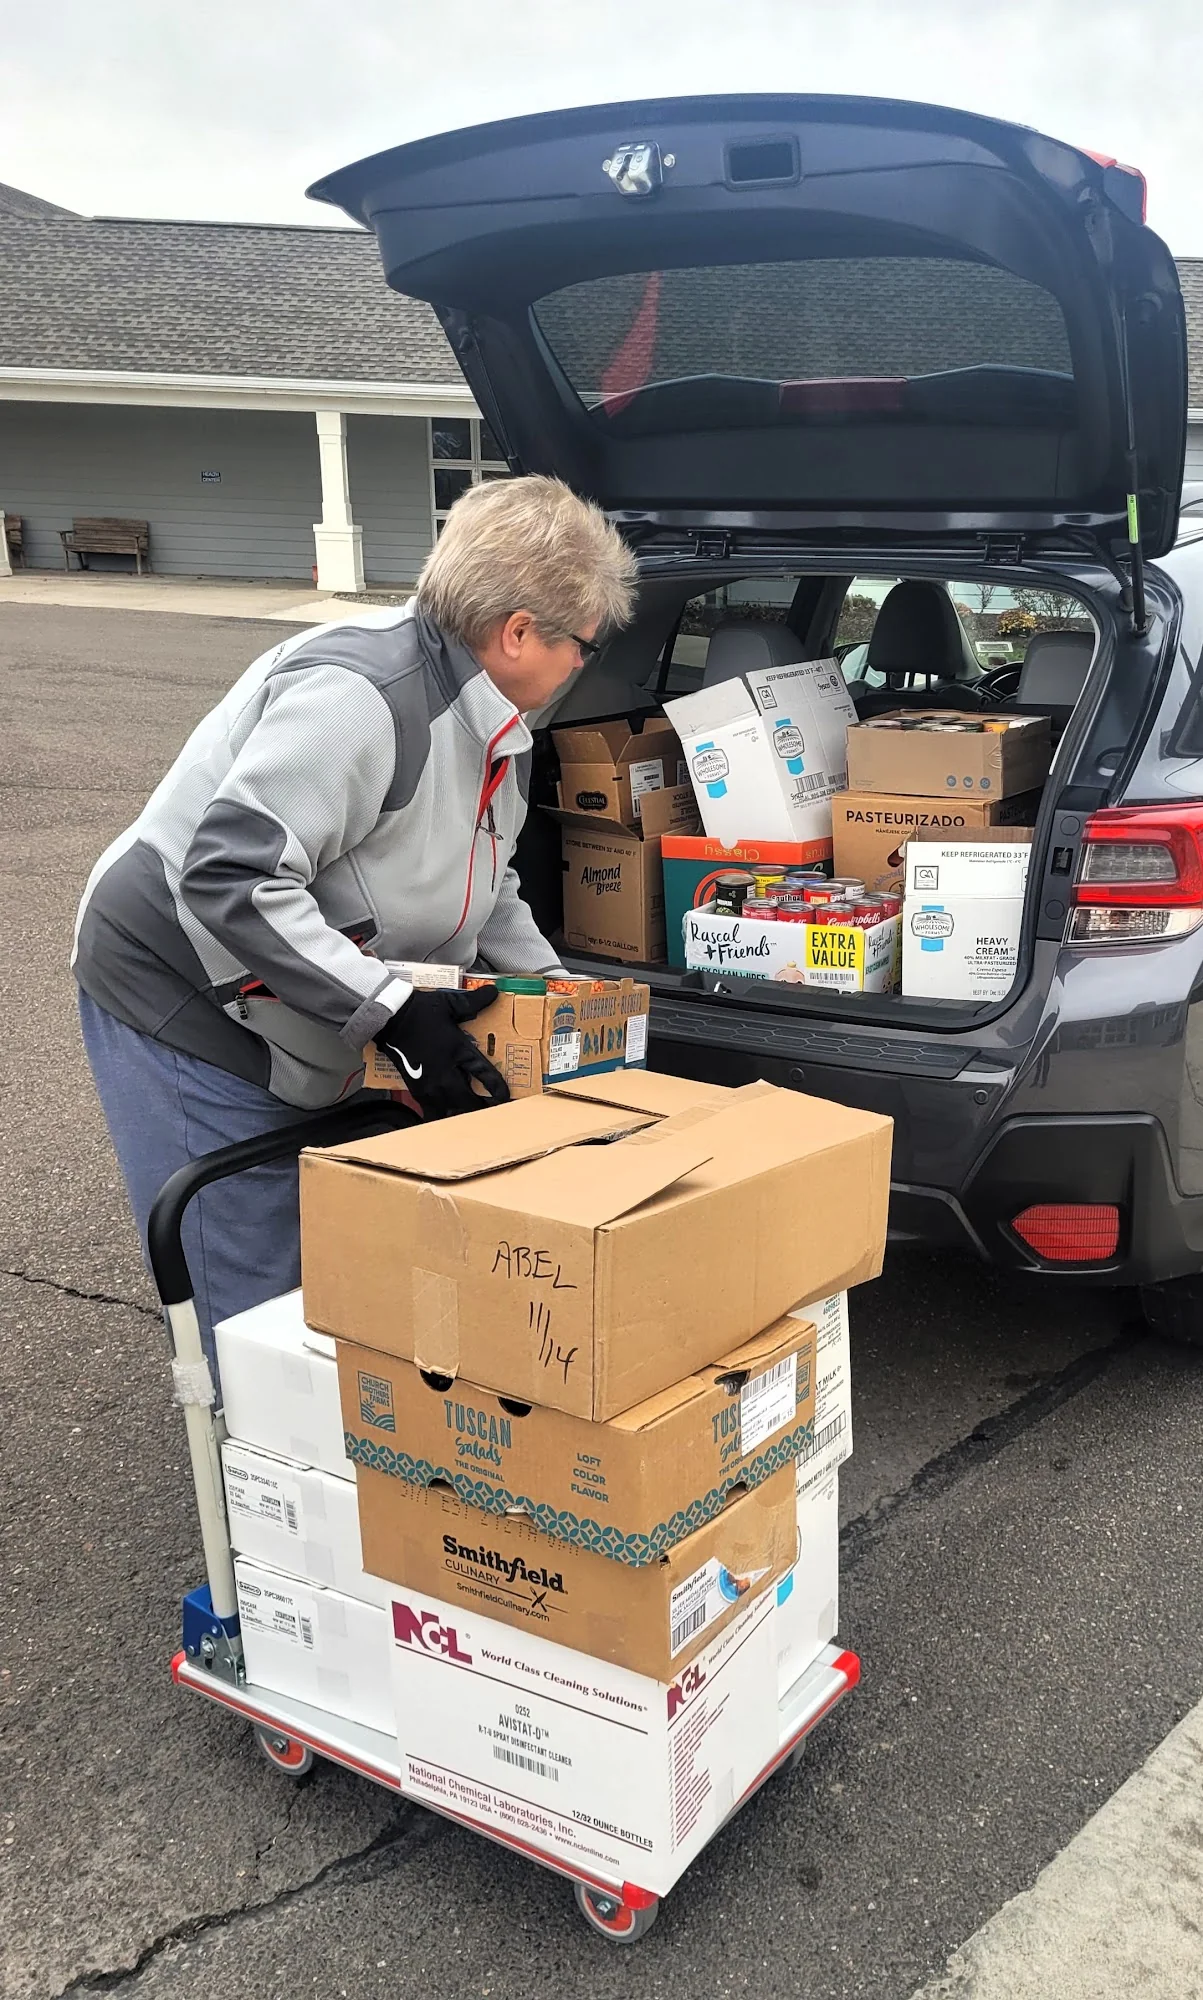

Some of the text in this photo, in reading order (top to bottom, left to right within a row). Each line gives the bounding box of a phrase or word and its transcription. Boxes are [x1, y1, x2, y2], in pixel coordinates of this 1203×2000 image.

[778, 740, 802, 751] WHOLESOME
[698, 763, 726, 777] WHOLESOME
[846, 810, 966, 827] PASTEURIZADO
[705, 846, 760, 861] Classy
[580, 863, 621, 884] Almond
[596, 882, 622, 895] Breeze
[690, 920, 741, 943] Rascal
[914, 924, 950, 932] WHOLESOME
[612, 941, 639, 953] GALLONS
[812, 932, 856, 950] EXTRA
[976, 937, 1008, 945] HEAVY
[812, 950, 856, 968] VALUE
[976, 947, 1008, 955] CREAM
[492, 1241, 578, 1289] ABEL
[529, 1302, 578, 1384] 11/14
[362, 1376, 388, 1392] CHURCH
[823, 1368, 836, 1386] MILK
[362, 1385, 389, 1399] BROTHERS
[370, 1394, 390, 1407] FARMS
[444, 1399, 512, 1448] TUSCAN
[712, 1399, 741, 1444] TUS
[454, 1436, 503, 1466] Salads
[577, 1452, 601, 1466] LOFT
[454, 1459, 505, 1483] THE ORIGINAL
[573, 1468, 606, 1485] COLOR
[719, 1466, 730, 1477] THE
[570, 1483, 609, 1503] FLAVOR
[442, 1534, 565, 1594] Smithfield
[445, 1559, 500, 1585] CULINARY
[672, 1568, 707, 1603] Smithfield
[456, 1582, 550, 1622] SmithfieldCulinary.com
[481, 1649, 643, 1712] World Class Cleaning Solutions
[515, 1704, 531, 1718] 0252
[493, 1730, 510, 1744] SPRAY
[511, 1734, 547, 1757] DISINFECTANT
[548, 1750, 572, 1766] CLEANER
[408, 1763, 576, 1839] National Chemical Laboratories, Inc.
[409, 1775, 448, 1796] Philadelphia,
[450, 1791, 458, 1800] PA
[459, 1794, 478, 1808] 19123
[479, 1801, 493, 1814] USA
[572, 1810, 653, 1849] 12/32 OUNCE BOTTLES
